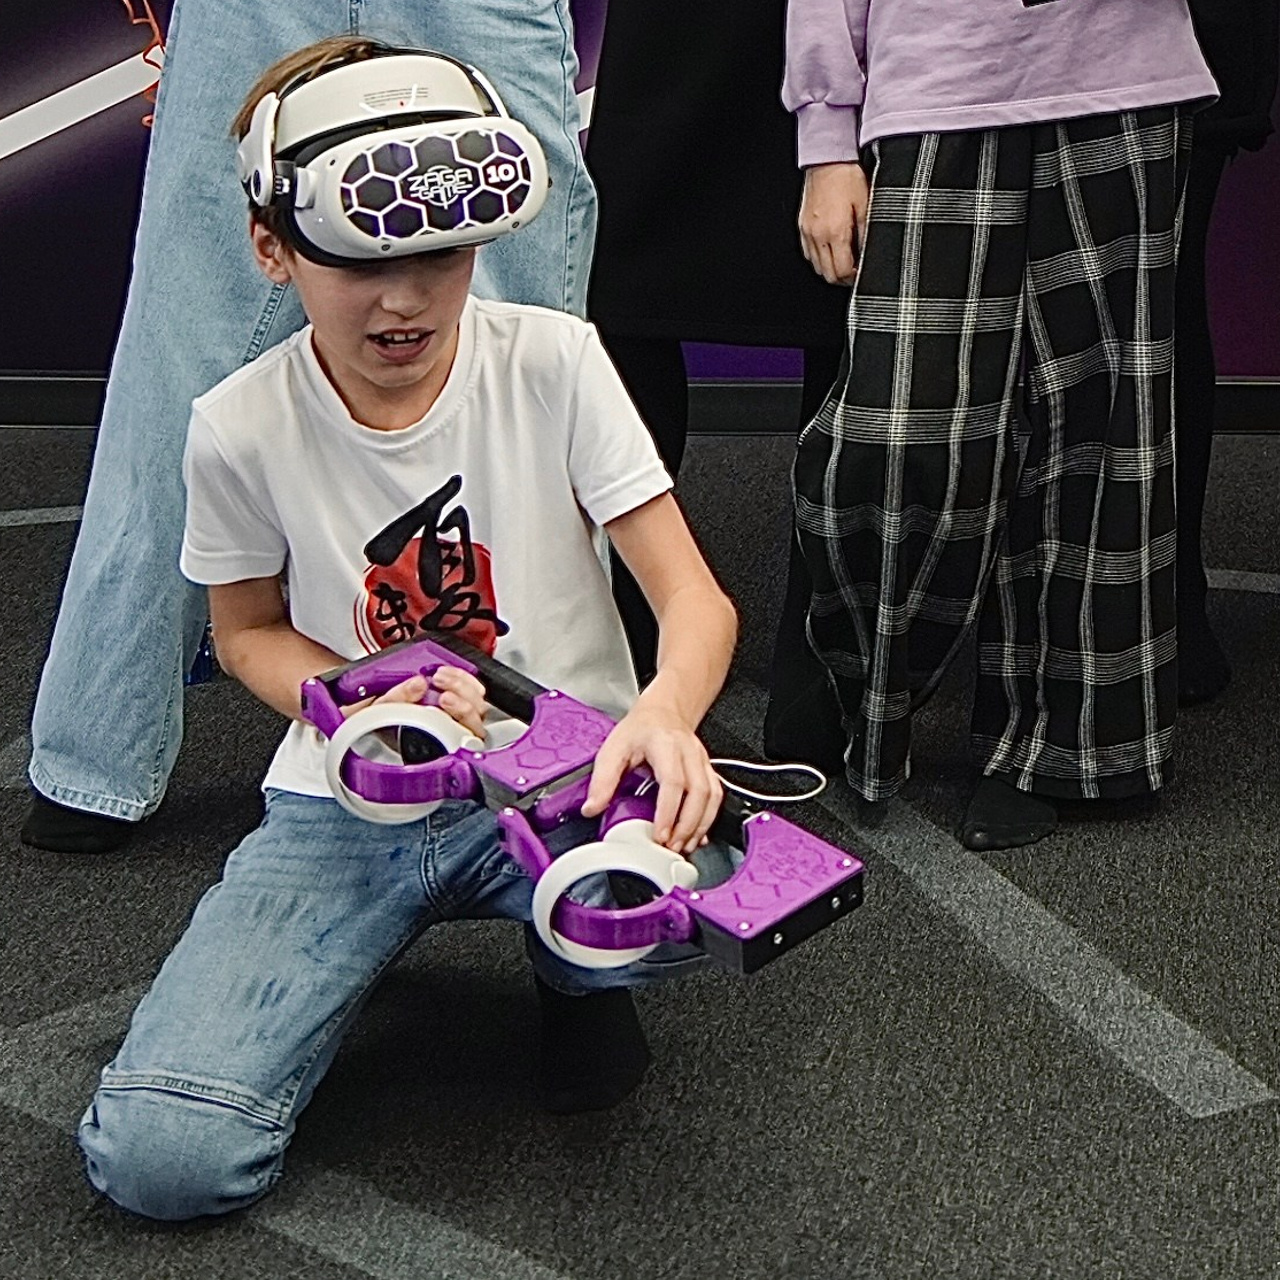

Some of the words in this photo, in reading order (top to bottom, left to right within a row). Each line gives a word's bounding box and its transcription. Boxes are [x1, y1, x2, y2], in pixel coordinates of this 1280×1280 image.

[408, 169, 472, 191] ZAGA
[486, 163, 515, 183] 10
[410, 183, 472, 204] GAME
